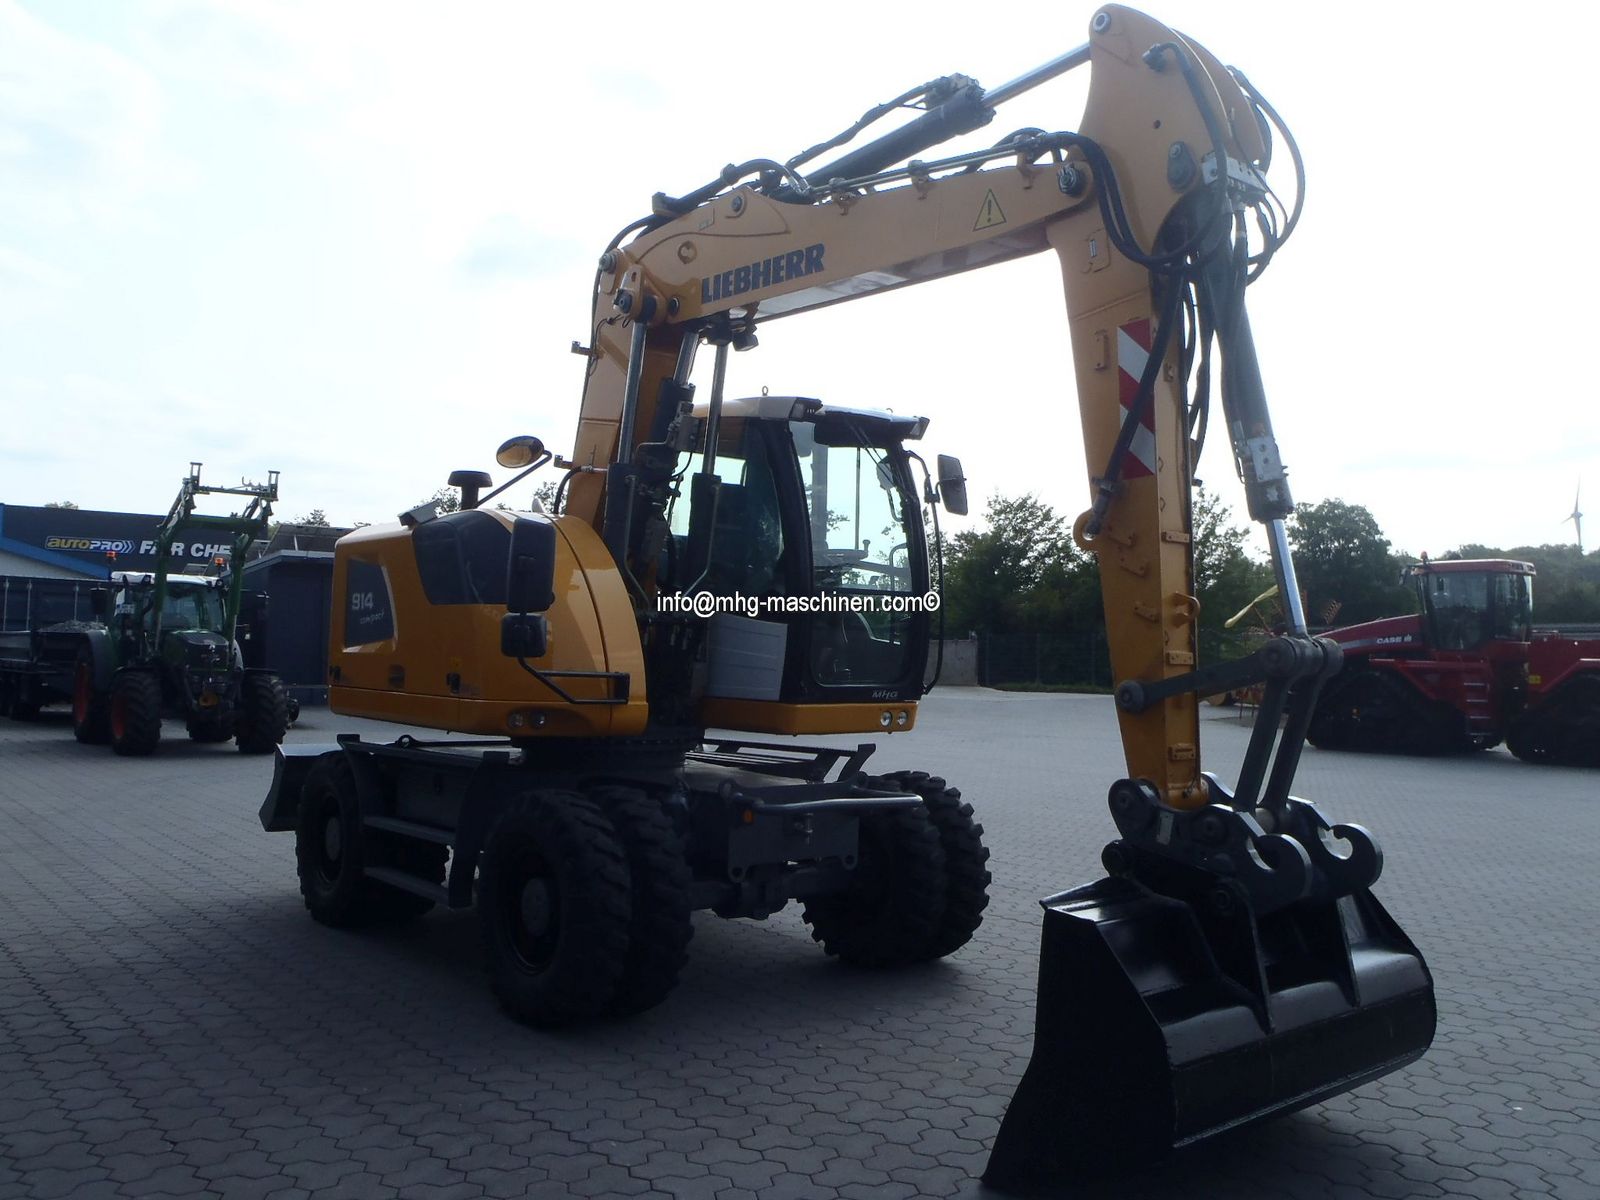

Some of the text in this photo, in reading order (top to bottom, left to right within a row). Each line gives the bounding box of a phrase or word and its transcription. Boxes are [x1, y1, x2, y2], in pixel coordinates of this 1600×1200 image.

[702, 243, 825, 304] LIEBHERR
[139, 540, 185, 556] FAR
[352, 592, 374, 610] 914
[1376, 636, 1402, 644] CASE
